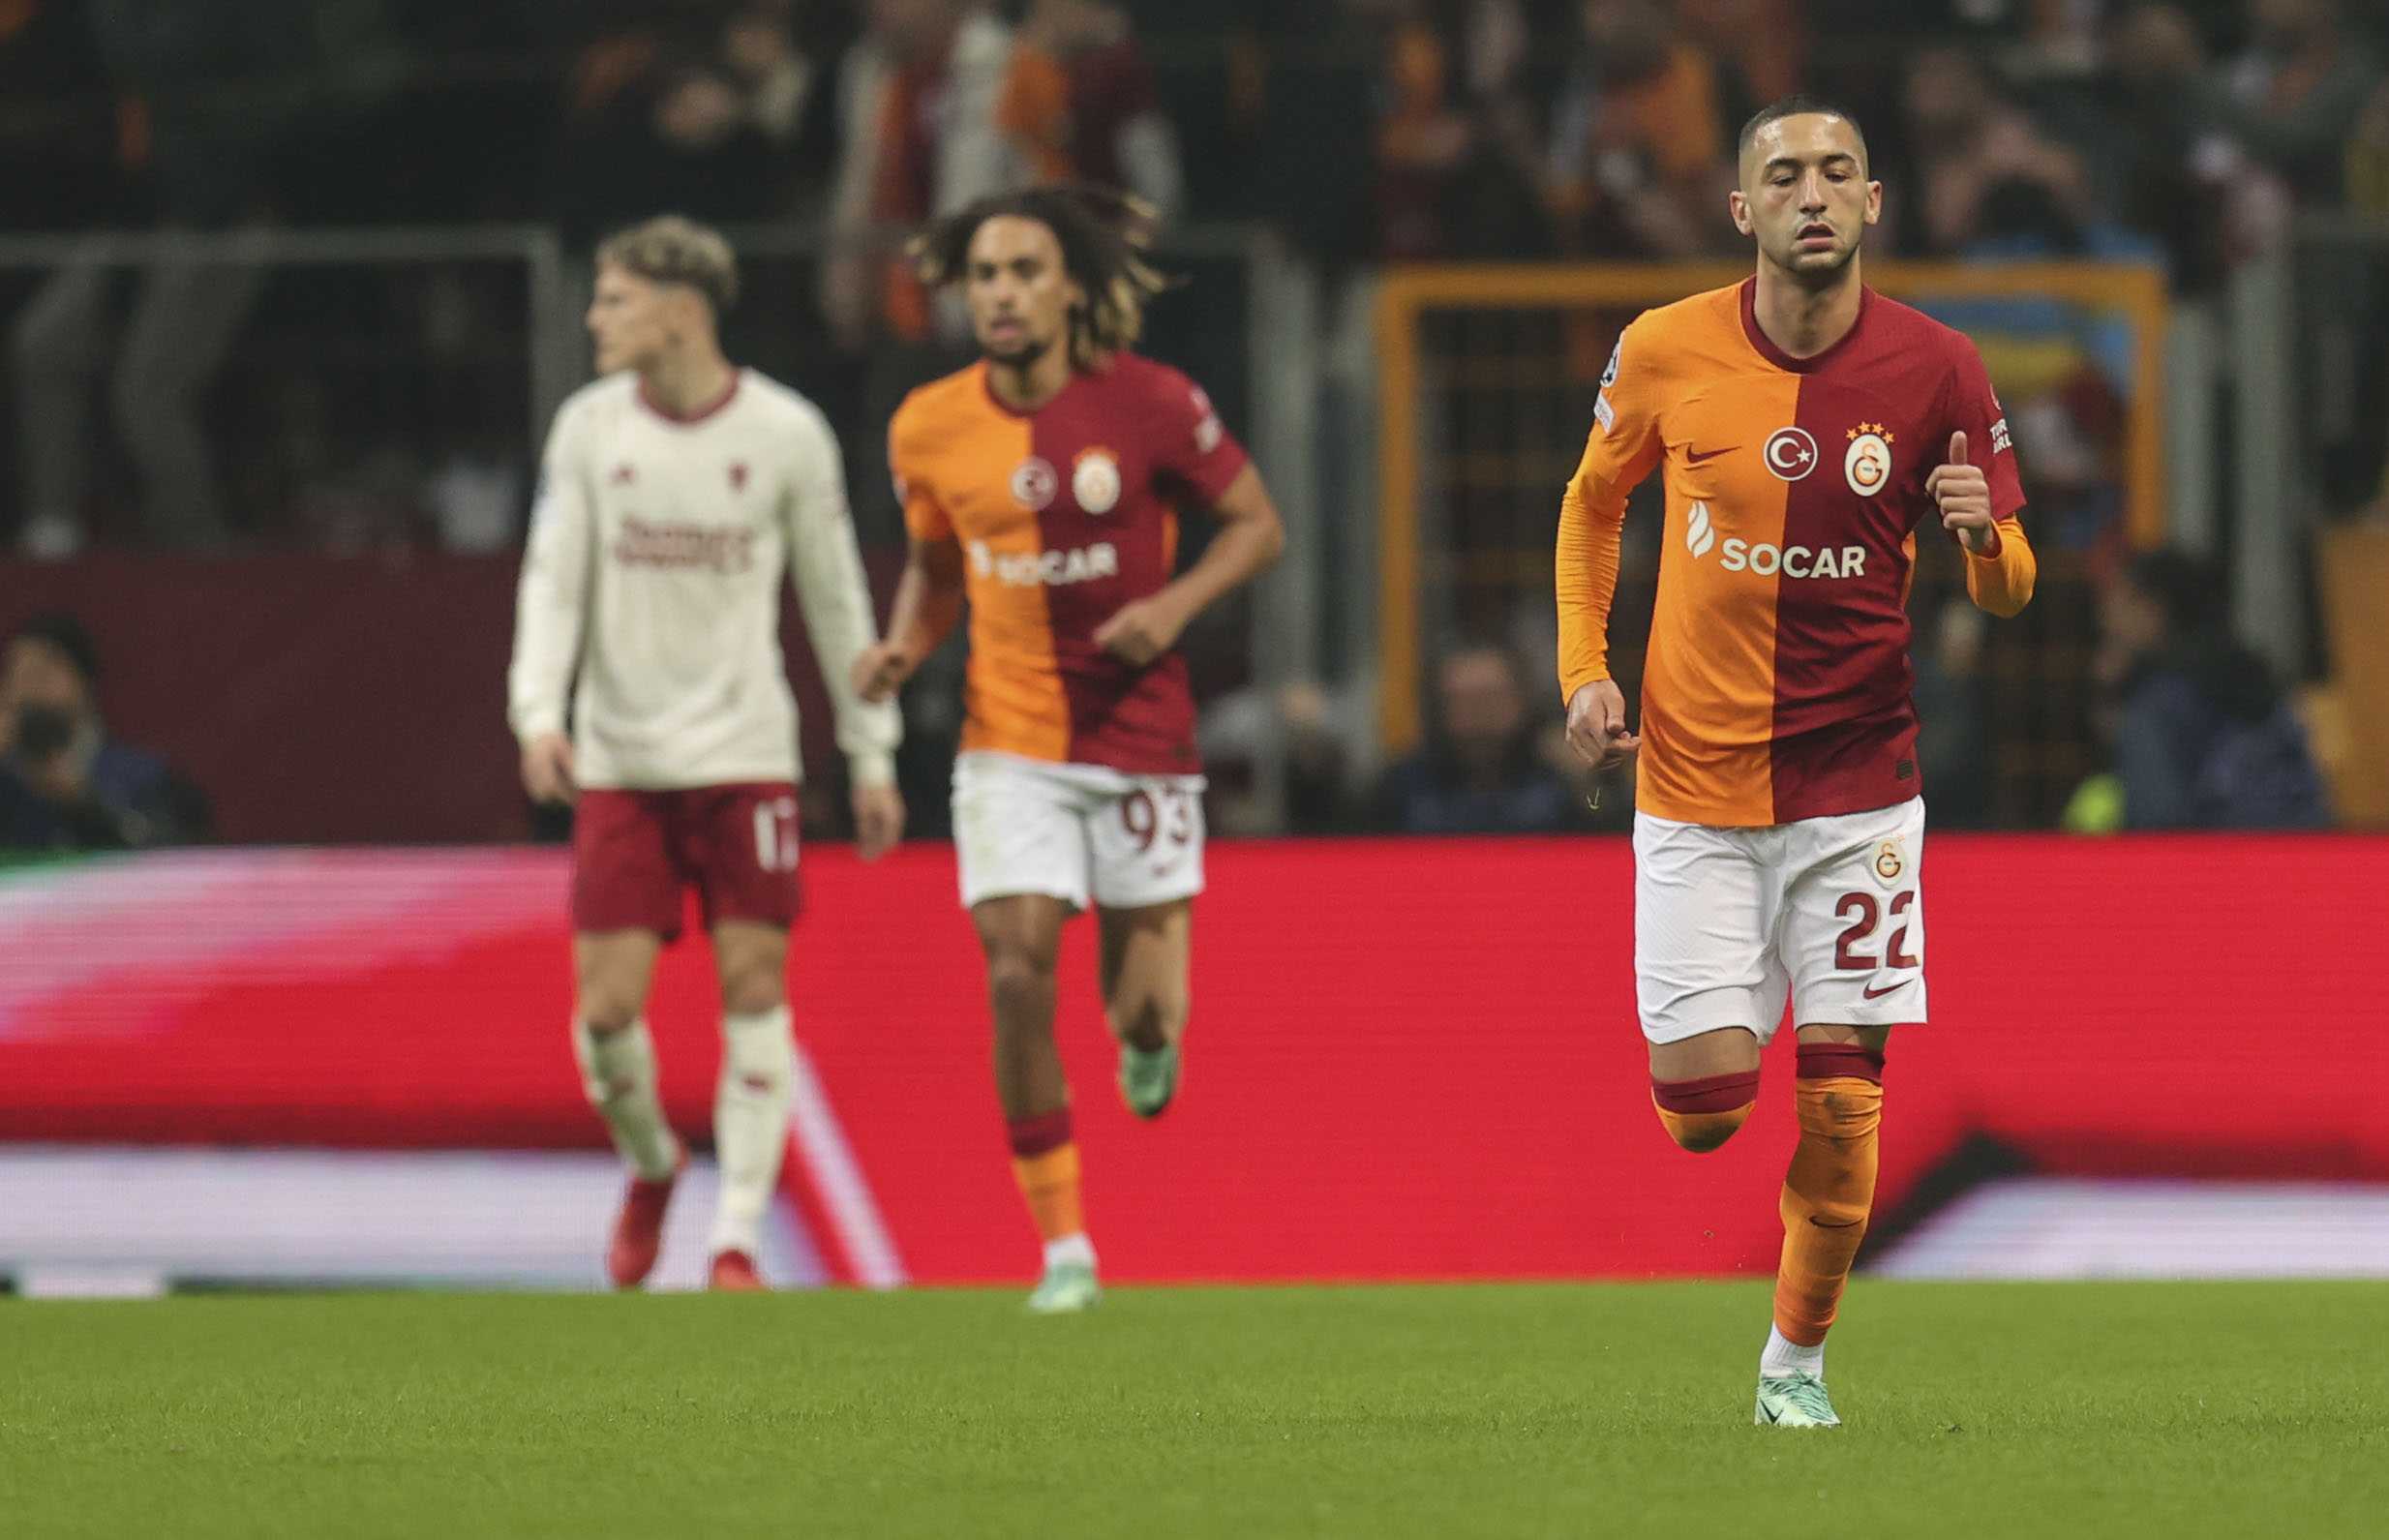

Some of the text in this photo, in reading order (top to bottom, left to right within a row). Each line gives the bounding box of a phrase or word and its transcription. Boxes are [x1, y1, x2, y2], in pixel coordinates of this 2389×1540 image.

[1719, 538, 1866, 579] SOCAR
[1120, 781, 1191, 853] 93
[1834, 890, 1919, 970] 22
